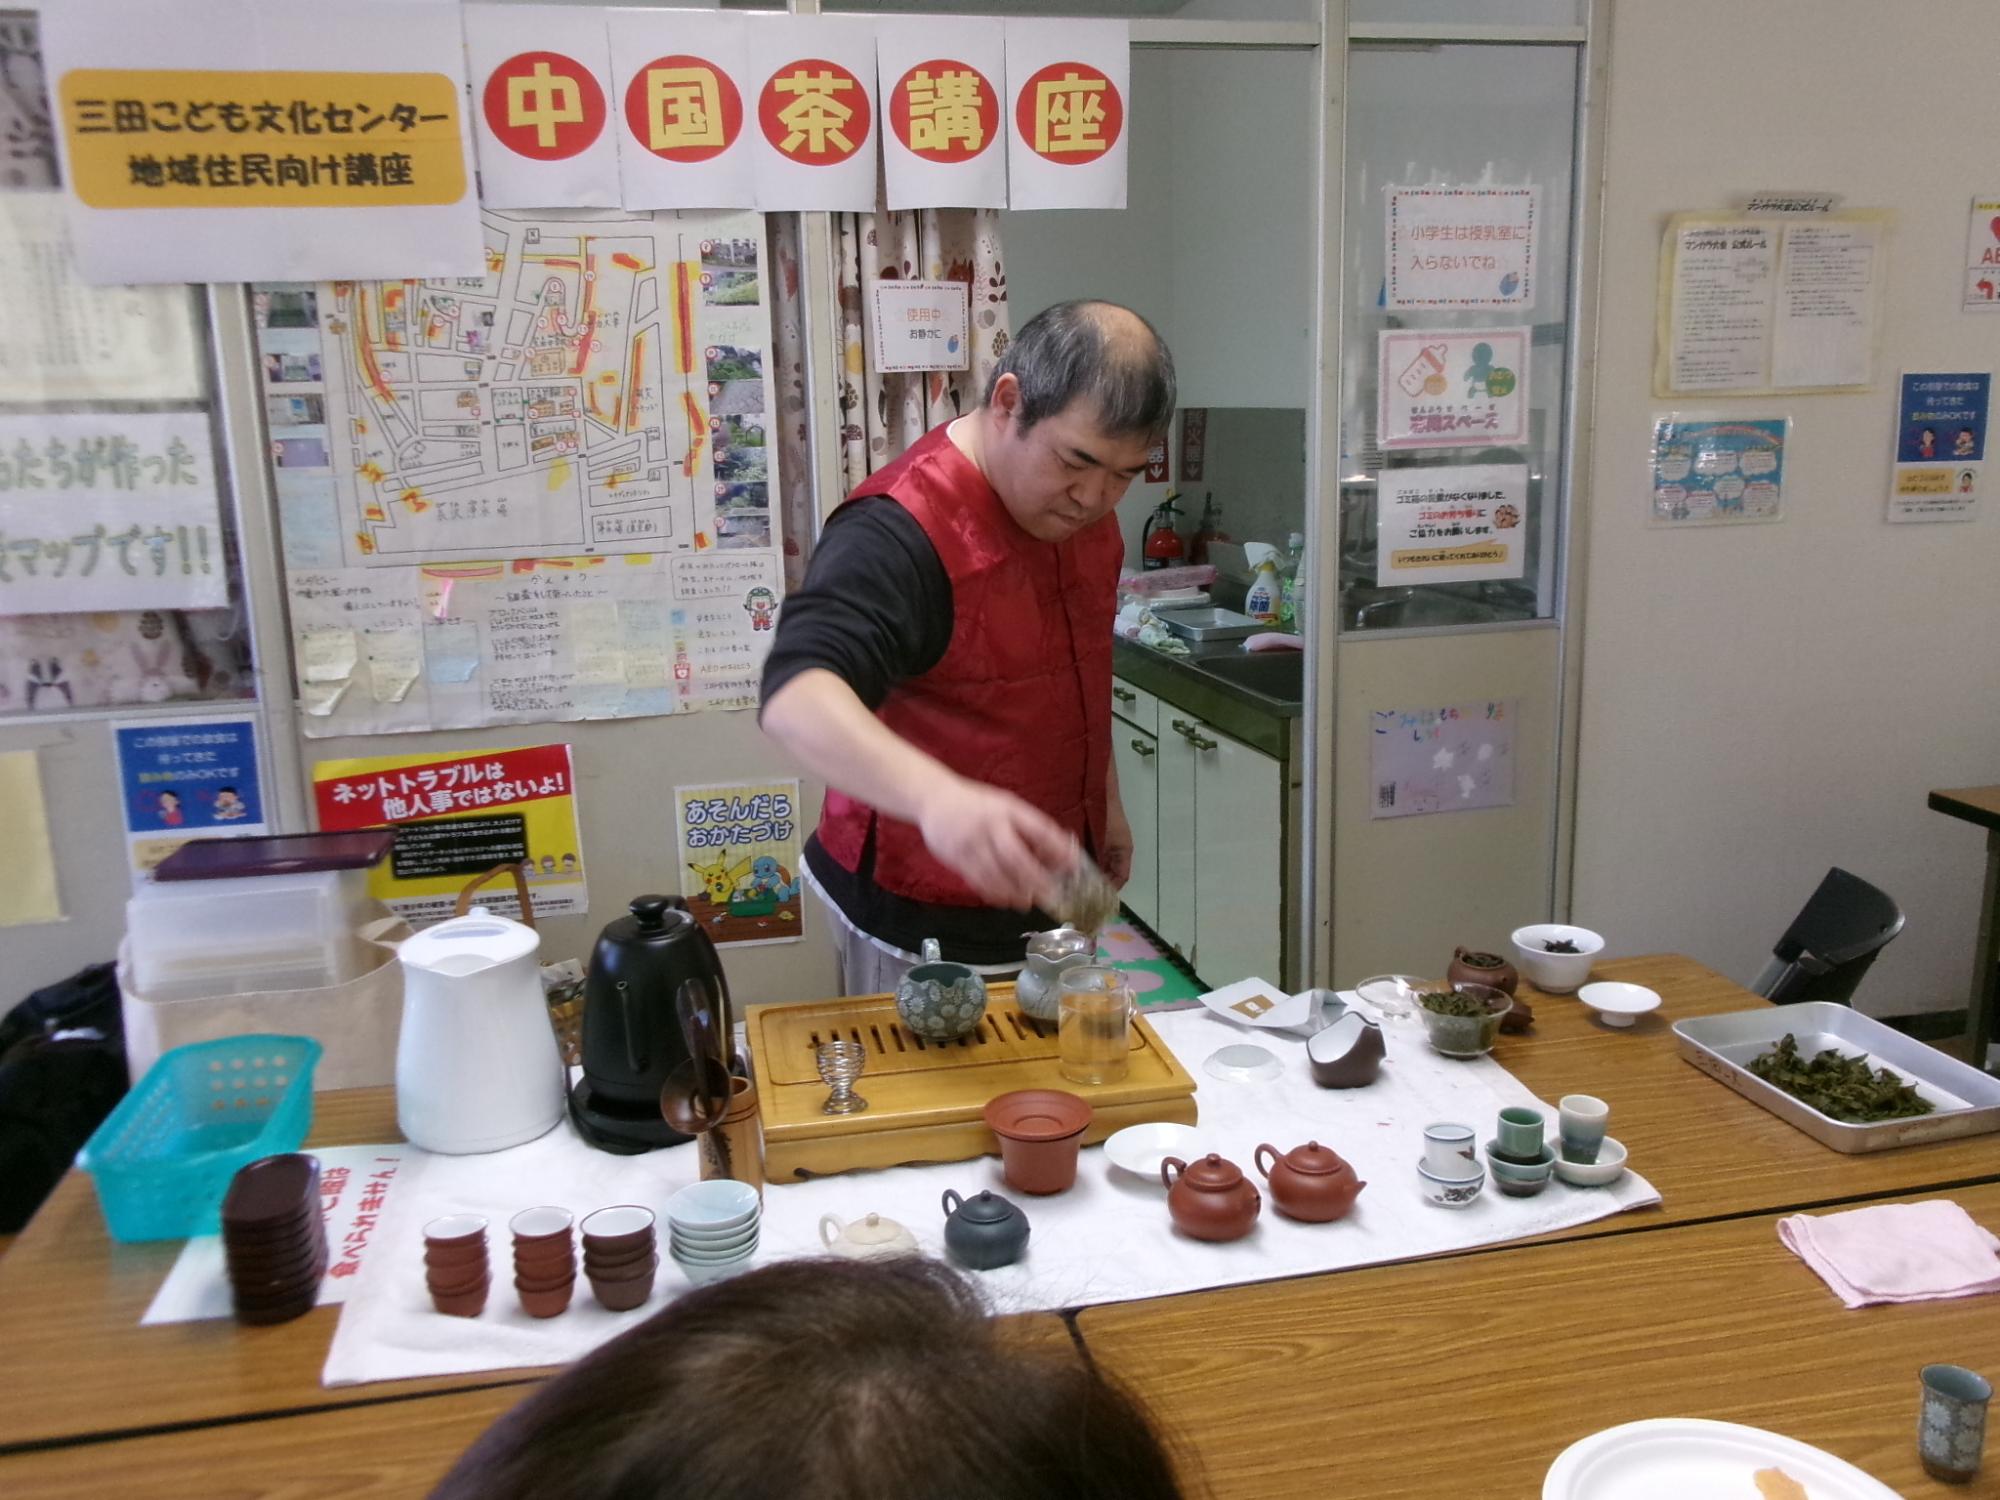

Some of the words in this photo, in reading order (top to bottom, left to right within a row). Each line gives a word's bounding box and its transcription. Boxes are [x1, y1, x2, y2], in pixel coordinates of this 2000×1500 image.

[75, 99, 449, 134] 三田こども文化センター
[507, 62, 1106, 154] 中国茶講座
[129, 151, 414, 187] 地域住民向け講座
[1410, 225, 1526, 241] 小学生は授乳室に
[1410, 255, 1496, 270] 入らないでね
[906, 307, 941, 321] 使用中
[332, 762, 506, 805] ネットトラブルは
[382, 772, 566, 822] 他人事ではないよ!
[686, 794, 792, 824] あそんだら
[687, 820, 794, 848] おかたづけ
